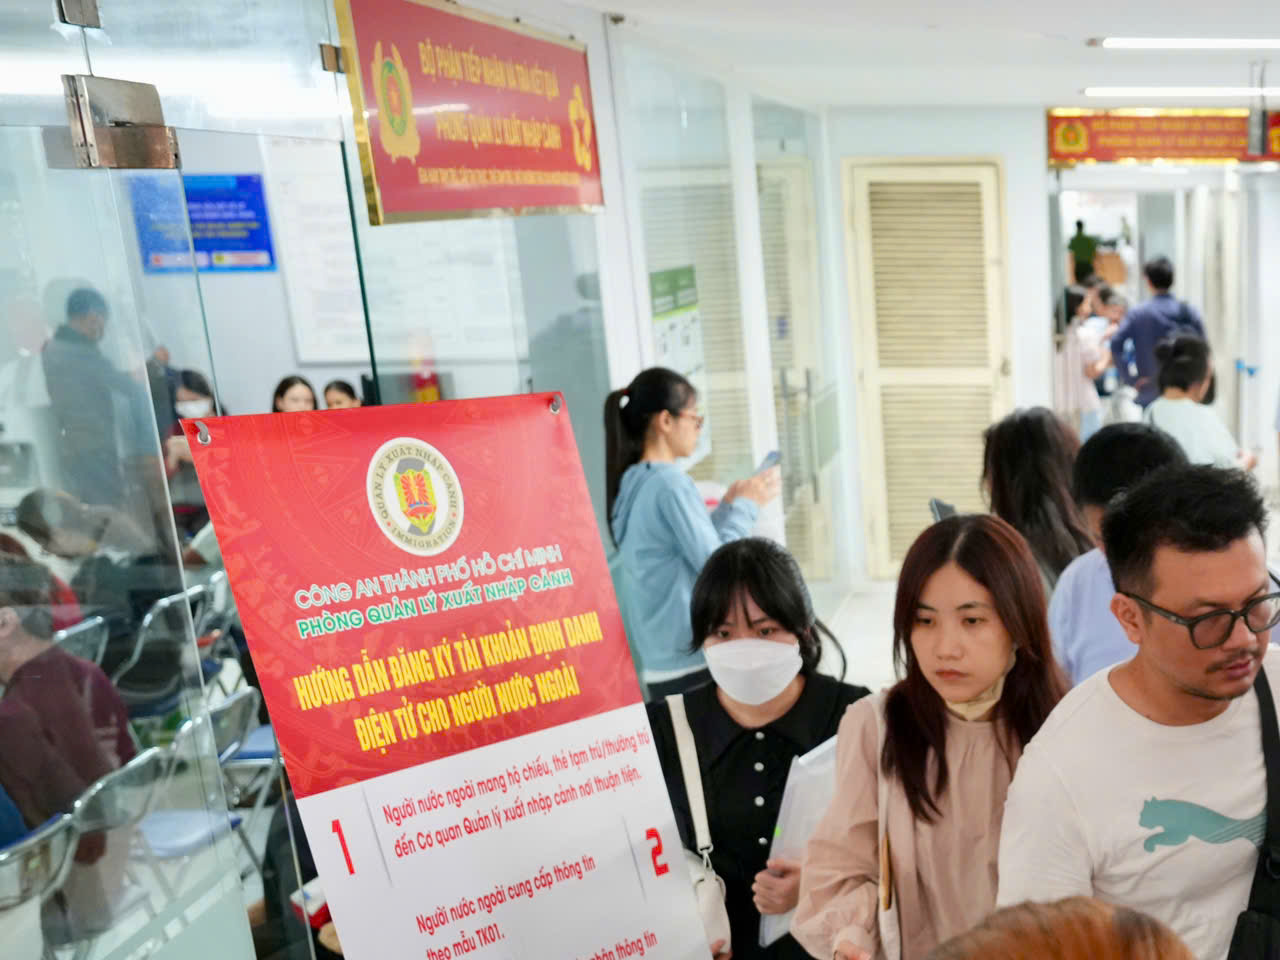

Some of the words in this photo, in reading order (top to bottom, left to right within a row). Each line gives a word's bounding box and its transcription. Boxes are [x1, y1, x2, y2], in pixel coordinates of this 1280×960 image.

[391, 521, 456, 548] IMMIGRATION
[295, 583, 352, 609] CÔNG
[355, 576, 382, 599] AN
[380, 567, 437, 593] THÀNH
[435, 555, 470, 584] PHỐ
[470, 551, 497, 578] HỒ
[497, 547, 525, 572] CHÍ
[524, 544, 563, 567] MINH
[296, 609, 364, 639] PHÒNG
[366, 595, 418, 625] QUẢN
[417, 589, 438, 615] LÝ
[439, 580, 483, 612] XUẤT
[483, 575, 527, 602] NHẬP
[529, 567, 574, 592] CẢNH
[293, 664, 356, 712] HƯỚNG
[351, 648, 392, 697] DẪN
[387, 647, 435, 689] ĐĂNG
[432, 636, 456, 678] KÝ
[453, 632, 483, 673] TÀI
[479, 619, 532, 667] KHOẢN
[528, 619, 567, 660] ĐỊNH
[562, 611, 603, 648] DANH
[353, 707, 398, 755] ĐIỆN
[393, 695, 418, 741] TỬ
[416, 697, 451, 735] CHO
[448, 679, 498, 727] NGƯỜI
[494, 671, 537, 714] NƯỚC
[534, 660, 581, 705] NGOÀI
[382, 797, 417, 827] Người
[417, 789, 445, 813] nước
[446, 779, 476, 808] ngoài
[477, 774, 507, 794] mang
[505, 764, 522, 789] hộ
[522, 754, 554, 781] chiếu,
[552, 748, 568, 772] thẻ
[568, 749, 589, 771] tạm
[588, 734, 639, 761] trú/thường
[637, 727, 650, 745] trú
[394, 832, 417, 859] đến
[416, 830, 433, 850] Cơ
[435, 824, 463, 848] quan
[463, 809, 492, 834] Quản
[491, 804, 502, 830] lý
[503, 795, 526, 822] xuất
[527, 791, 553, 816] nhập
[553, 783, 578, 806] cảnh
[594, 769, 621, 792] thuận
[620, 764, 642, 787] tiện.
[331, 818, 355, 876] 1
[645, 827, 670, 877] 2
[415, 906, 449, 936] Người
[450, 897, 477, 922] nước
[477, 885, 506, 914] ngoài
[507, 879, 534, 899] cung
[533, 865, 553, 890] cấp
[553, 861, 583, 881] thông
[581, 854, 596, 872] tin
[452, 930, 477, 956] mẫu
[475, 922, 505, 948] TK01.
[616, 938, 645, 957] thông
[643, 930, 658, 948] tin
